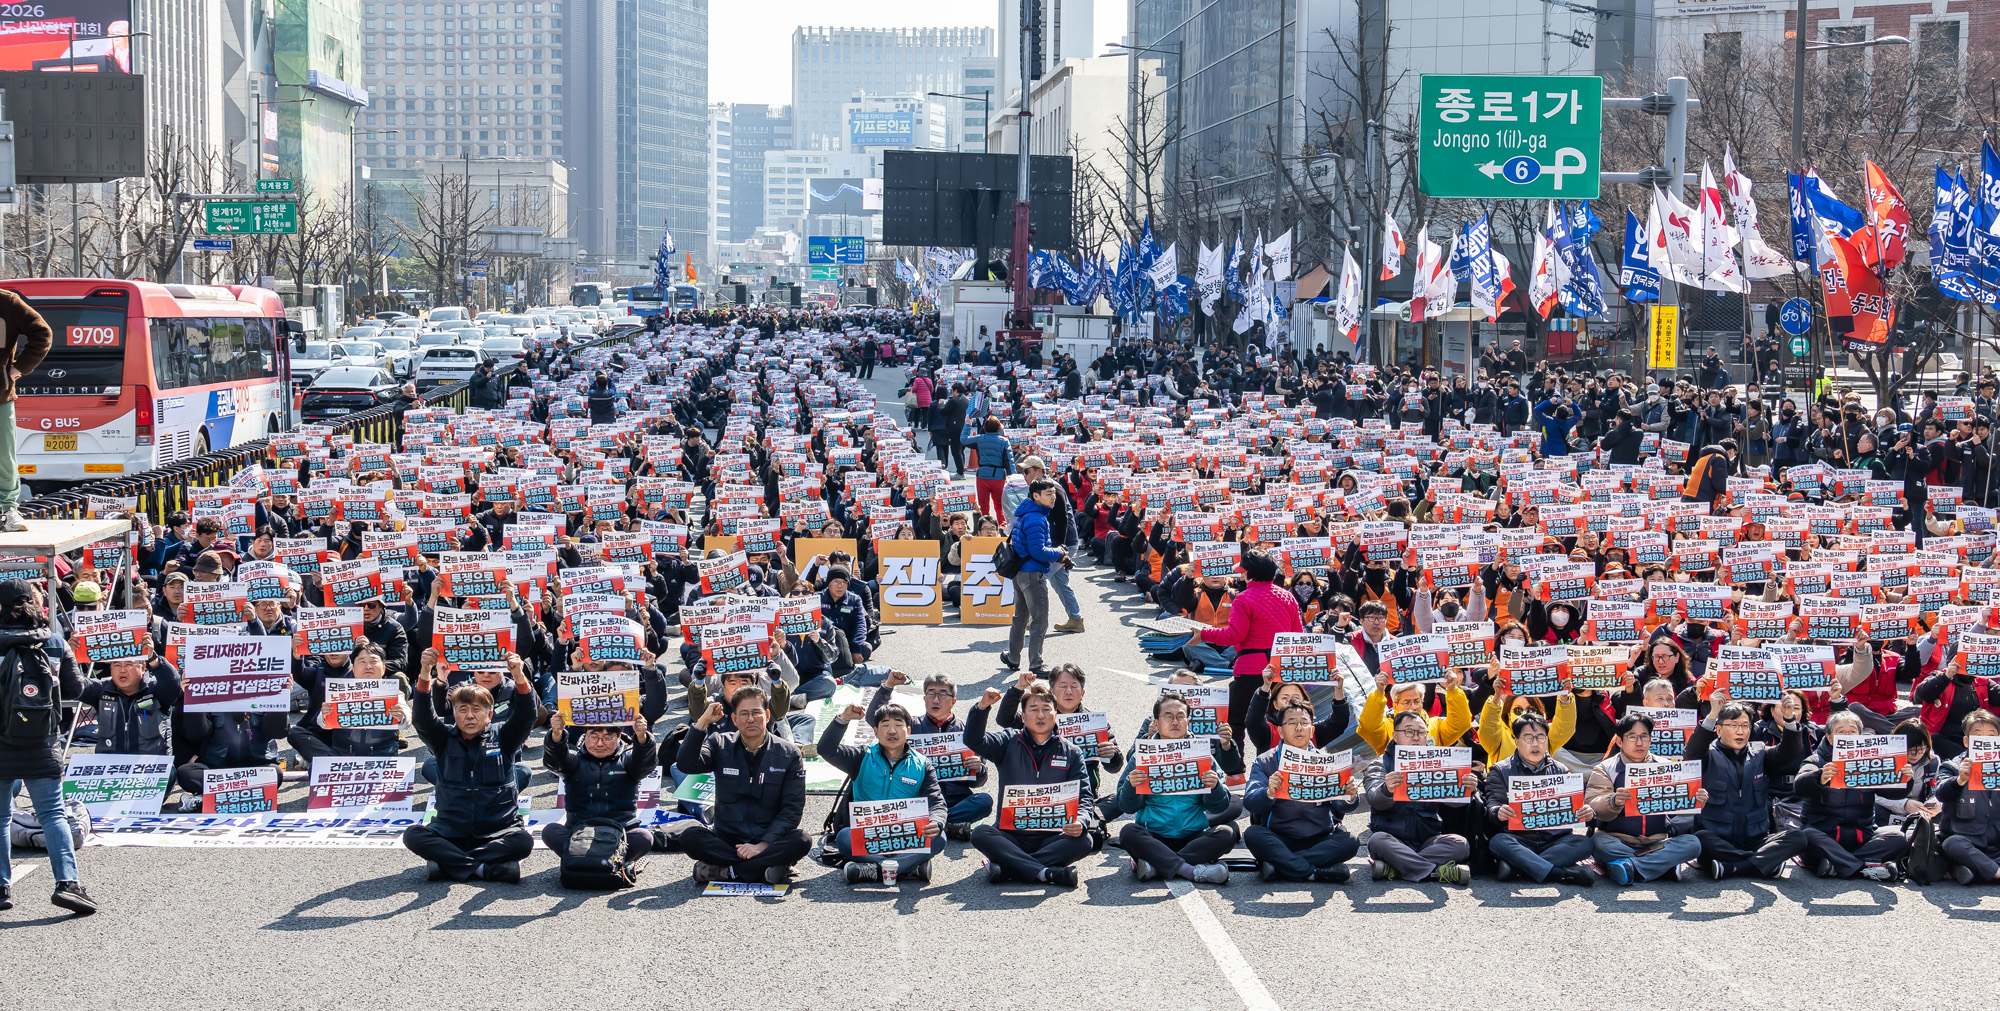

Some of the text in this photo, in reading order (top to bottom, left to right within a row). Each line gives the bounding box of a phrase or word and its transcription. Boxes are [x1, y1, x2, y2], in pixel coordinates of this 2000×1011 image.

[1, 4, 45, 17] 2026
[1435, 88, 1583, 125] 종로1가
[853, 120, 911, 134] 기프트인포
[1433, 129, 1547, 153] Jongno 1(il)-ga
[1515, 161, 1529, 179] 6
[260, 182, 289, 190] 청계광장
[211, 207, 242, 217] 청계1가
[262, 204, 287, 213] 숭례문
[263, 220, 279, 228] 시청
[72, 328, 114, 344] 9709
[40, 417, 80, 429] G BUS
[750, 520, 769, 528] 노동자의
[742, 532, 773, 543] 투쟁으로
[880, 557, 940, 606] 쟁
[1590, 604, 1604, 612] 모든
[77, 612, 126, 625] 모든 노동자의
[437, 611, 490, 622] 모든 노동자의
[79, 623, 117, 635] 노동기본권
[438, 622, 480, 632] 노동기본권
[1596, 619, 1634, 630] 투쟁으로
[705, 625, 751, 638] 모든 노동자의
[1596, 630, 1639, 640] 쟁취하자!
[85, 631, 134, 647] 투쟁으로
[443, 632, 498, 647] 투쟁으로
[706, 635, 743, 647] 노동기본권
[87, 643, 142, 661] 쟁취하자!
[193, 642, 263, 660] 중대재해가
[444, 647, 505, 661] 쟁취하자!
[711, 643, 759, 660] 투쟁으로
[230, 657, 285, 674] 감소되는
[712, 655, 766, 673] 쟁취하자!
[329, 681, 379, 692] 모든 노동자의
[560, 674, 600, 686] 진짜사장
[581, 681, 617, 696] 나와라!
[331, 691, 370, 702] 노동기본권
[571, 694, 624, 712] 원청교섭
[337, 700, 385, 714] 투쟁으로
[338, 713, 393, 727] 쟁취하자!
[572, 707, 634, 725] 쟁취하자!
[1837, 737, 1888, 749] 모든 노동자의
[1398, 749, 1452, 760] 모든 노동자의
[1838, 748, 1879, 759] 노동기본권
[70, 764, 168, 777] 고품질 주택 건설로
[330, 760, 398, 772] 건설노동자도
[1400, 760, 1442, 771] 노동기본권
[1844, 757, 1895, 772] 투쟁으로
[102, 777, 158, 789] 주거안정에
[318, 771, 353, 783] 빨간날
[368, 771, 379, 780] 수
[382, 770, 405, 779] 있는
[1407, 770, 1459, 785] 투쟁으로
[1845, 770, 1902, 787] 쟁취하자!
[331, 783, 370, 796] 권리가
[371, 781, 409, 793] 보장된
[1407, 783, 1464, 800] 쟁취하자!
[853, 801, 907, 816] 모든 노동자의
[856, 813, 898, 826] 노동기본권
[863, 822, 917, 840] 투쟁으로
[866, 834, 925, 854] 쟁취하자!
